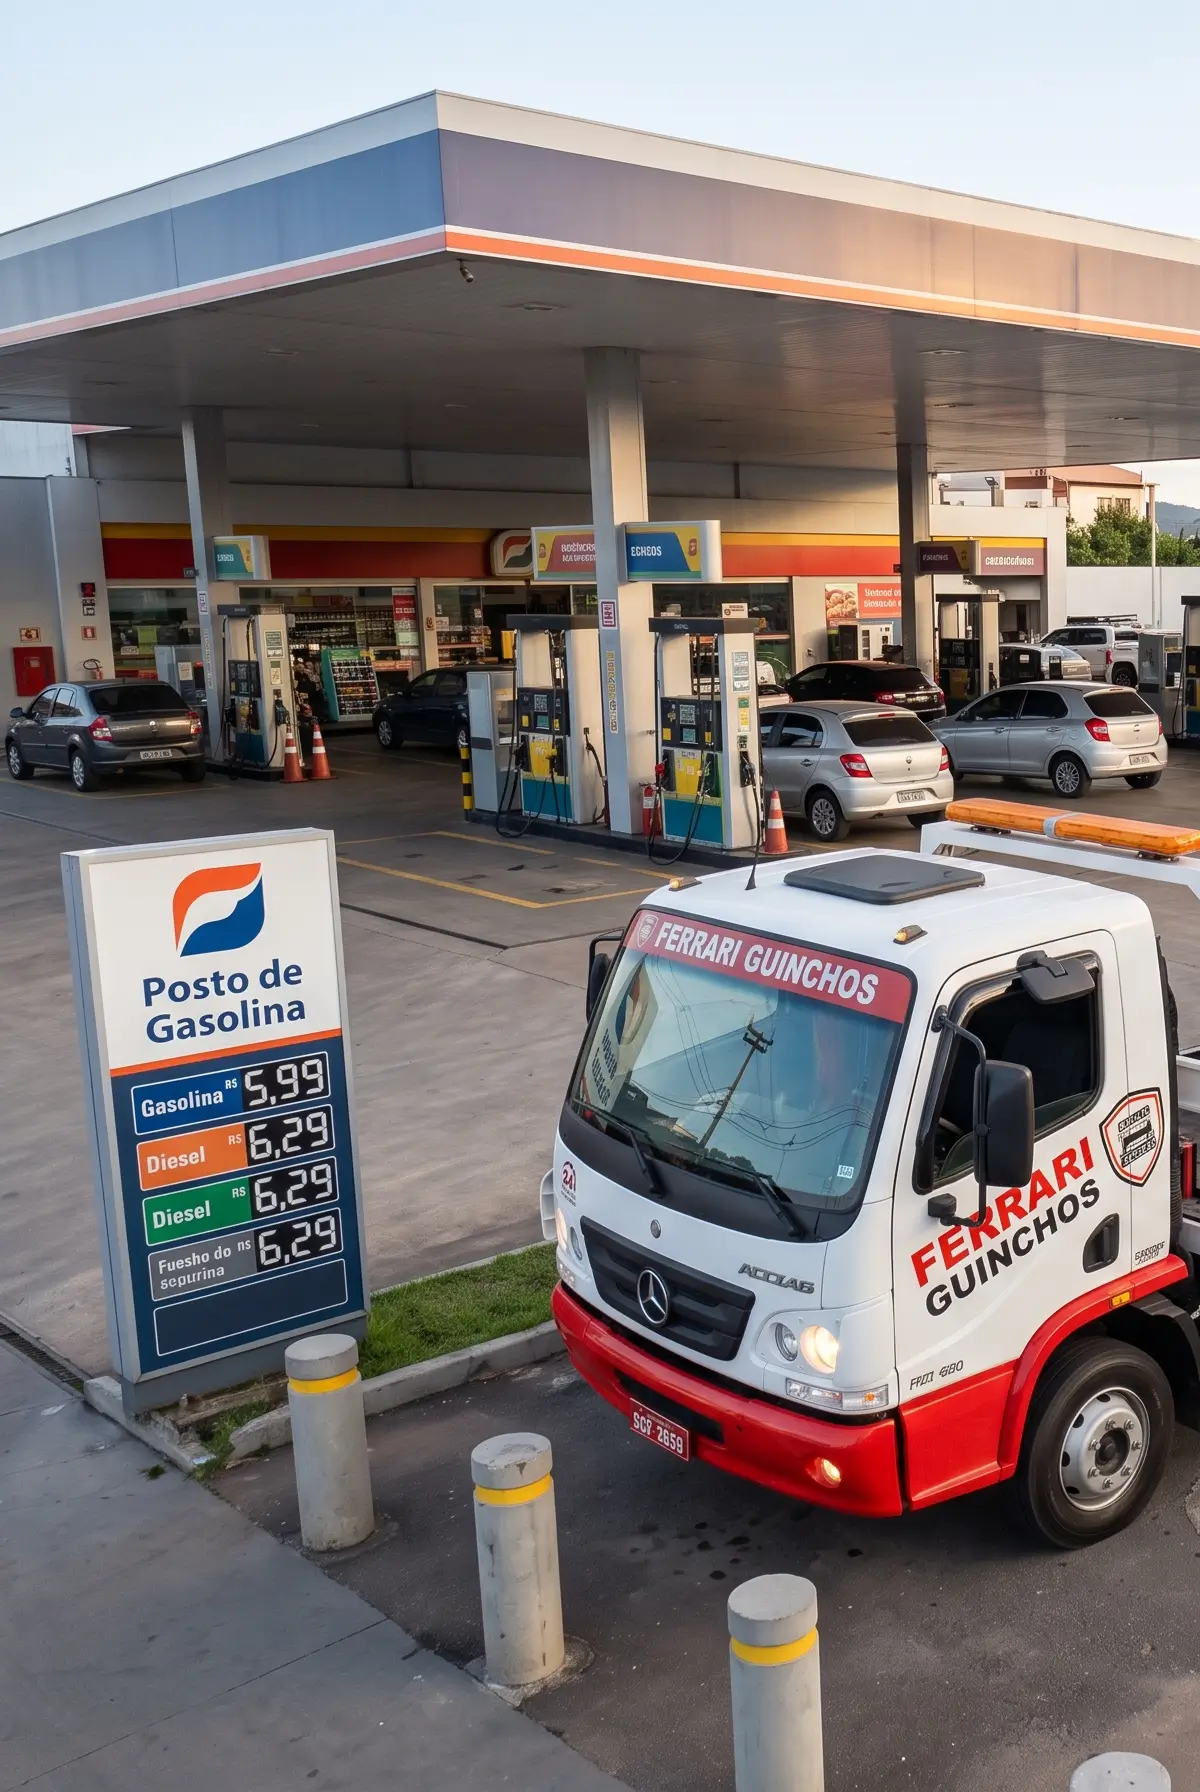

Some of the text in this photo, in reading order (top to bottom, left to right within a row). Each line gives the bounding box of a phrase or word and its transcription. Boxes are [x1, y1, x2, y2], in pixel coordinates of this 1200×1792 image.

[143, 958, 303, 1006] Posto de
[654, 921, 879, 1005] FERRARI GUINCHOS
[146, 999, 306, 1044] Gasolina
[141, 1090, 224, 1118] Gasolina
[244, 1058, 324, 1106] 5,99
[146, 1145, 206, 1174] Diesel
[249, 1111, 328, 1160] 6,29
[152, 1200, 211, 1229] Diesel
[254, 1163, 332, 1213] 6,29
[911, 1136, 1094, 1288] FERRARI
[213, 1244, 232, 1260] do
[258, 1215, 336, 1266] 6,29
[926, 1178, 1100, 1317] GUINCHOS
